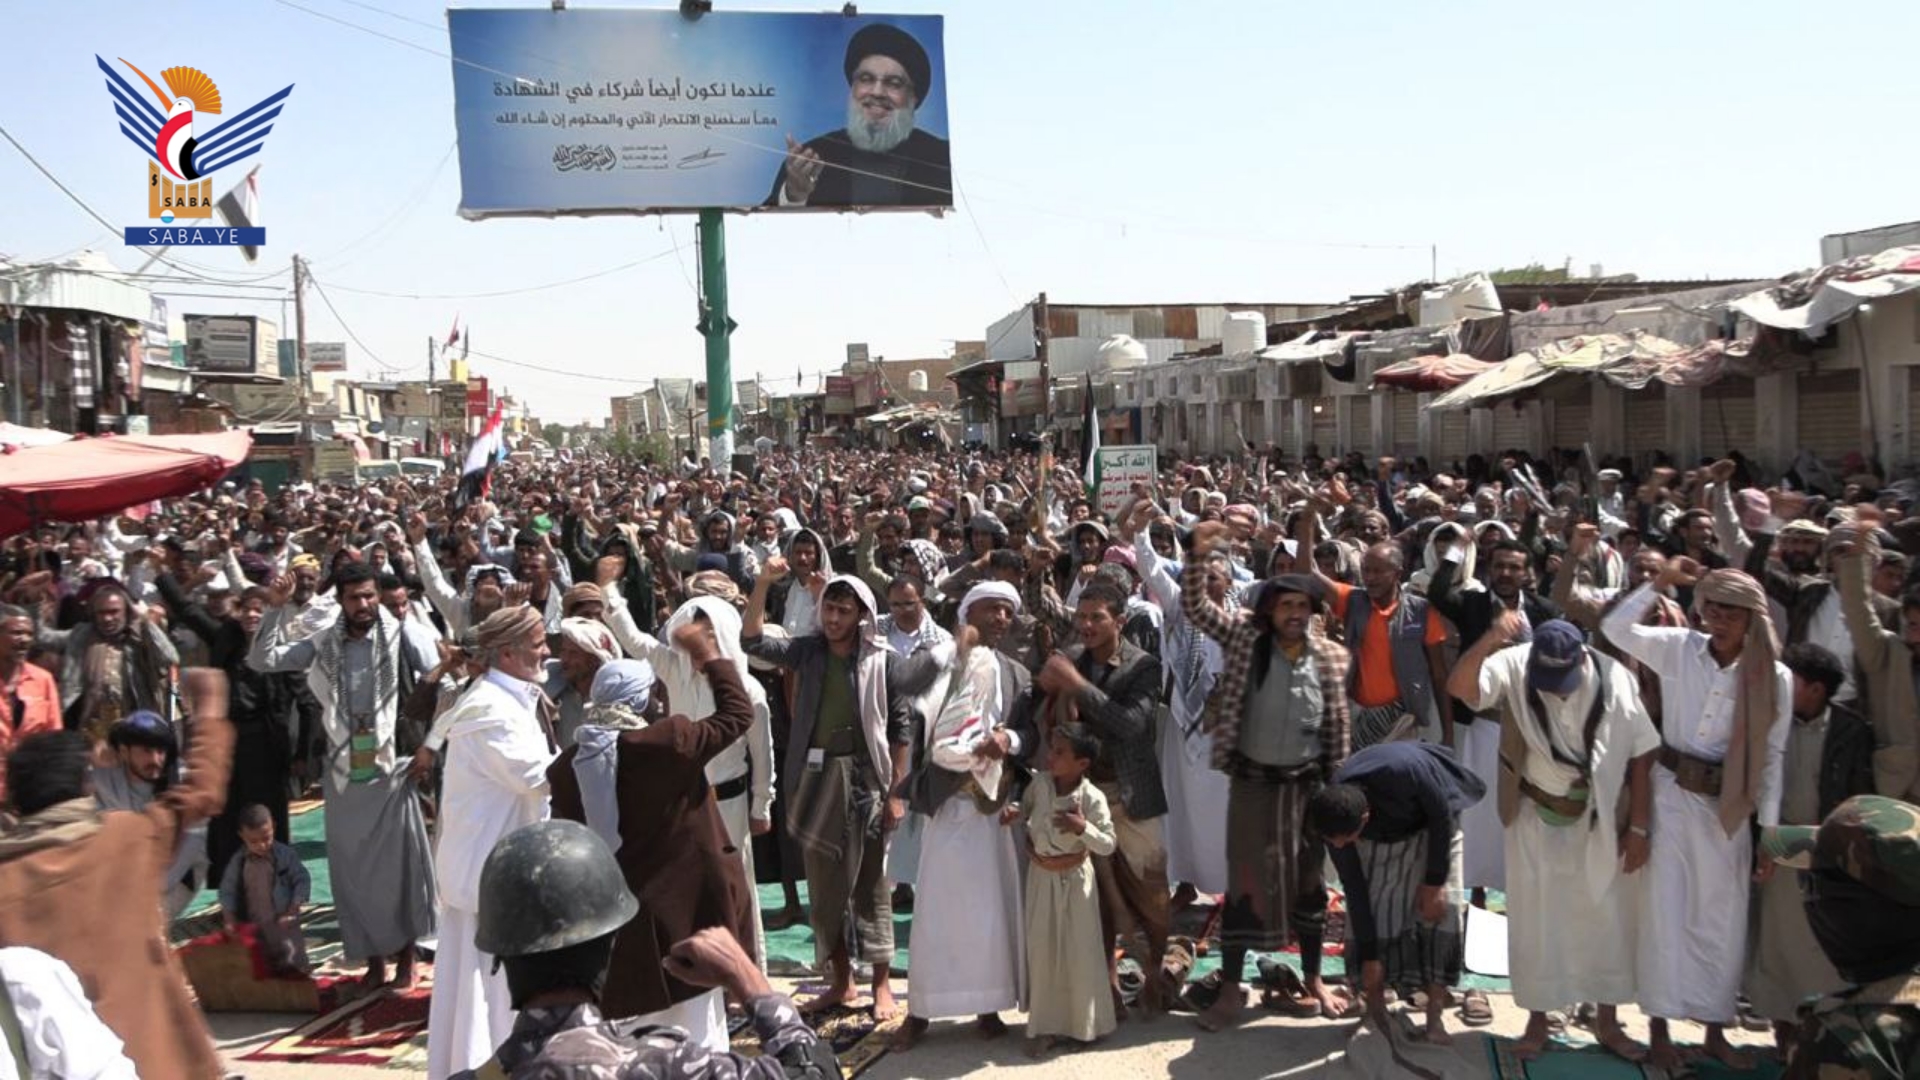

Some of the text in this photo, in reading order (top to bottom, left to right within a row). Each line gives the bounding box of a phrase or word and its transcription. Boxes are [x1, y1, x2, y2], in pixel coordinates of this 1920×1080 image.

[493, 78, 560, 97] الشهادة
[565, 82, 593, 103] في
[598, 79, 644, 100] شركاء
[686, 82, 727, 100] نكون
[731, 82, 776, 97] عندما
[496, 112, 518, 124] الله
[521, 111, 549, 124] شاء
[551, 113, 566, 128] إن
[568, 113, 623, 128] والمحتوم
[1131, 453, 1151, 467] الله
